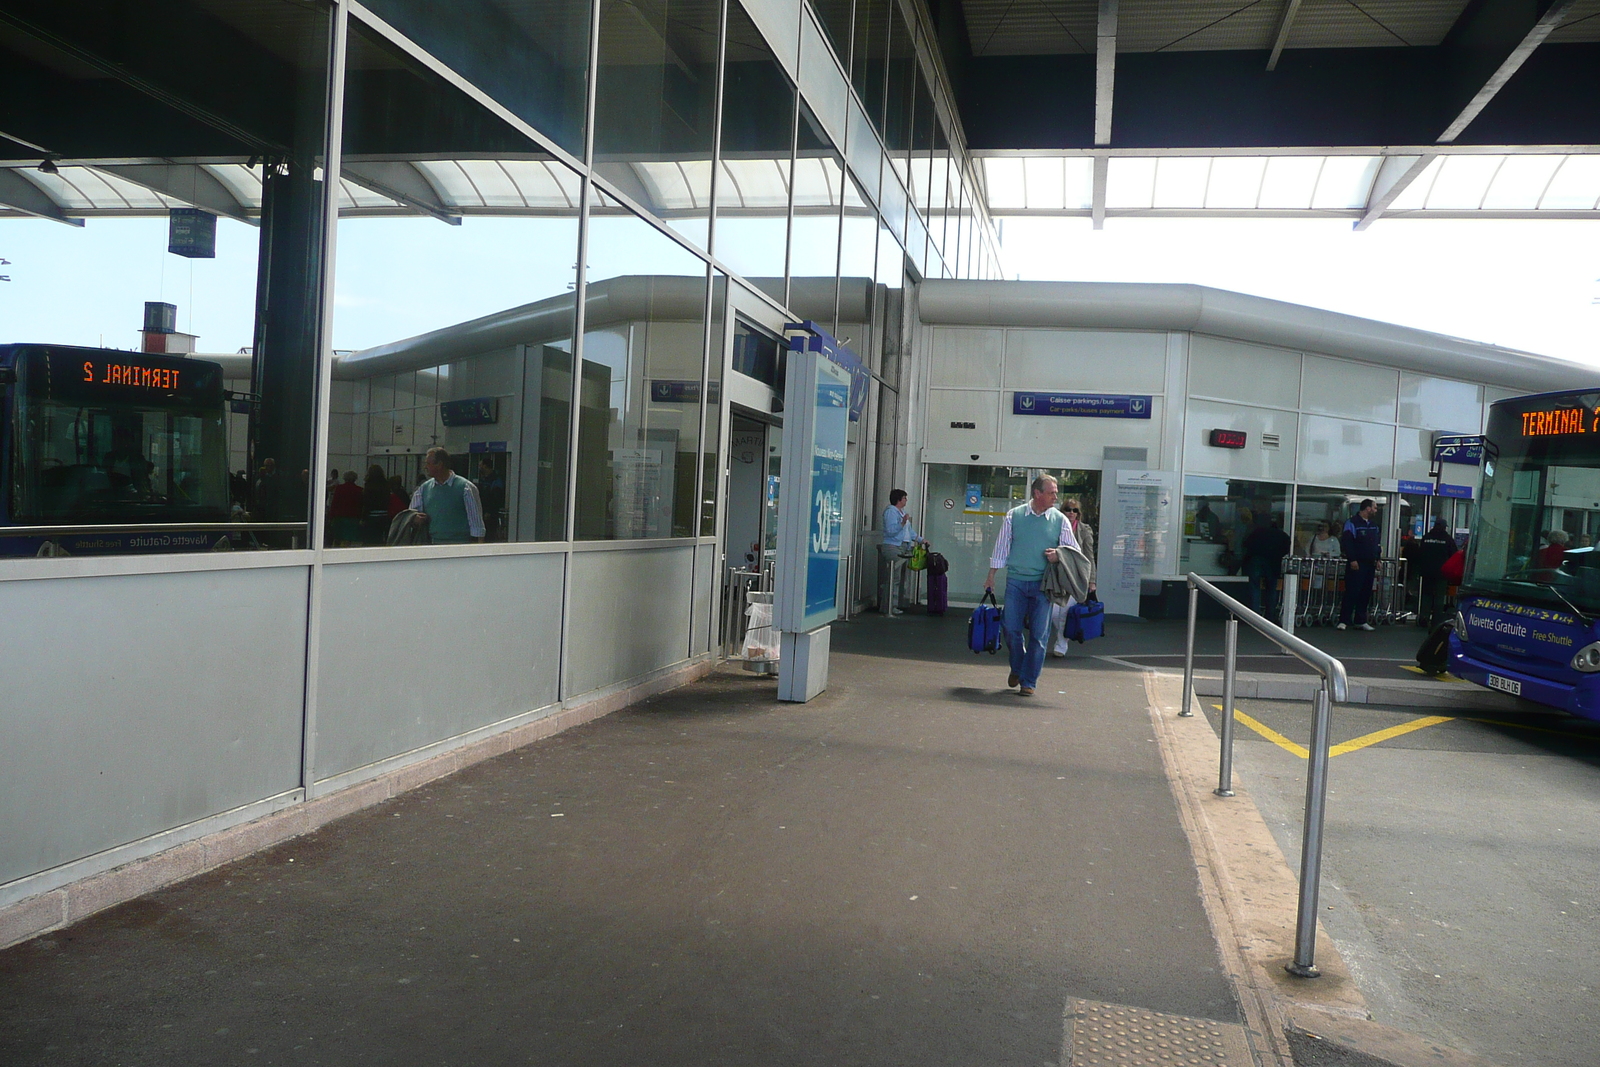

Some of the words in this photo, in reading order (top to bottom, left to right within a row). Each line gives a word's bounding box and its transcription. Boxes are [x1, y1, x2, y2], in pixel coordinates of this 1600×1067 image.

[1049, 396, 1072, 404] Caisse
[1072, 397, 1115, 406] parkings/bus
[1522, 408, 1586, 436] TERMINAL
[1468, 613, 1494, 630] Navette
[1494, 618, 1527, 638] Gratuite
[1532, 629, 1547, 642] Free
[1547, 632, 1573, 647] Shuttle
[1500, 678, 1511, 692] BLH
[1511, 681, 1519, 694] 06
